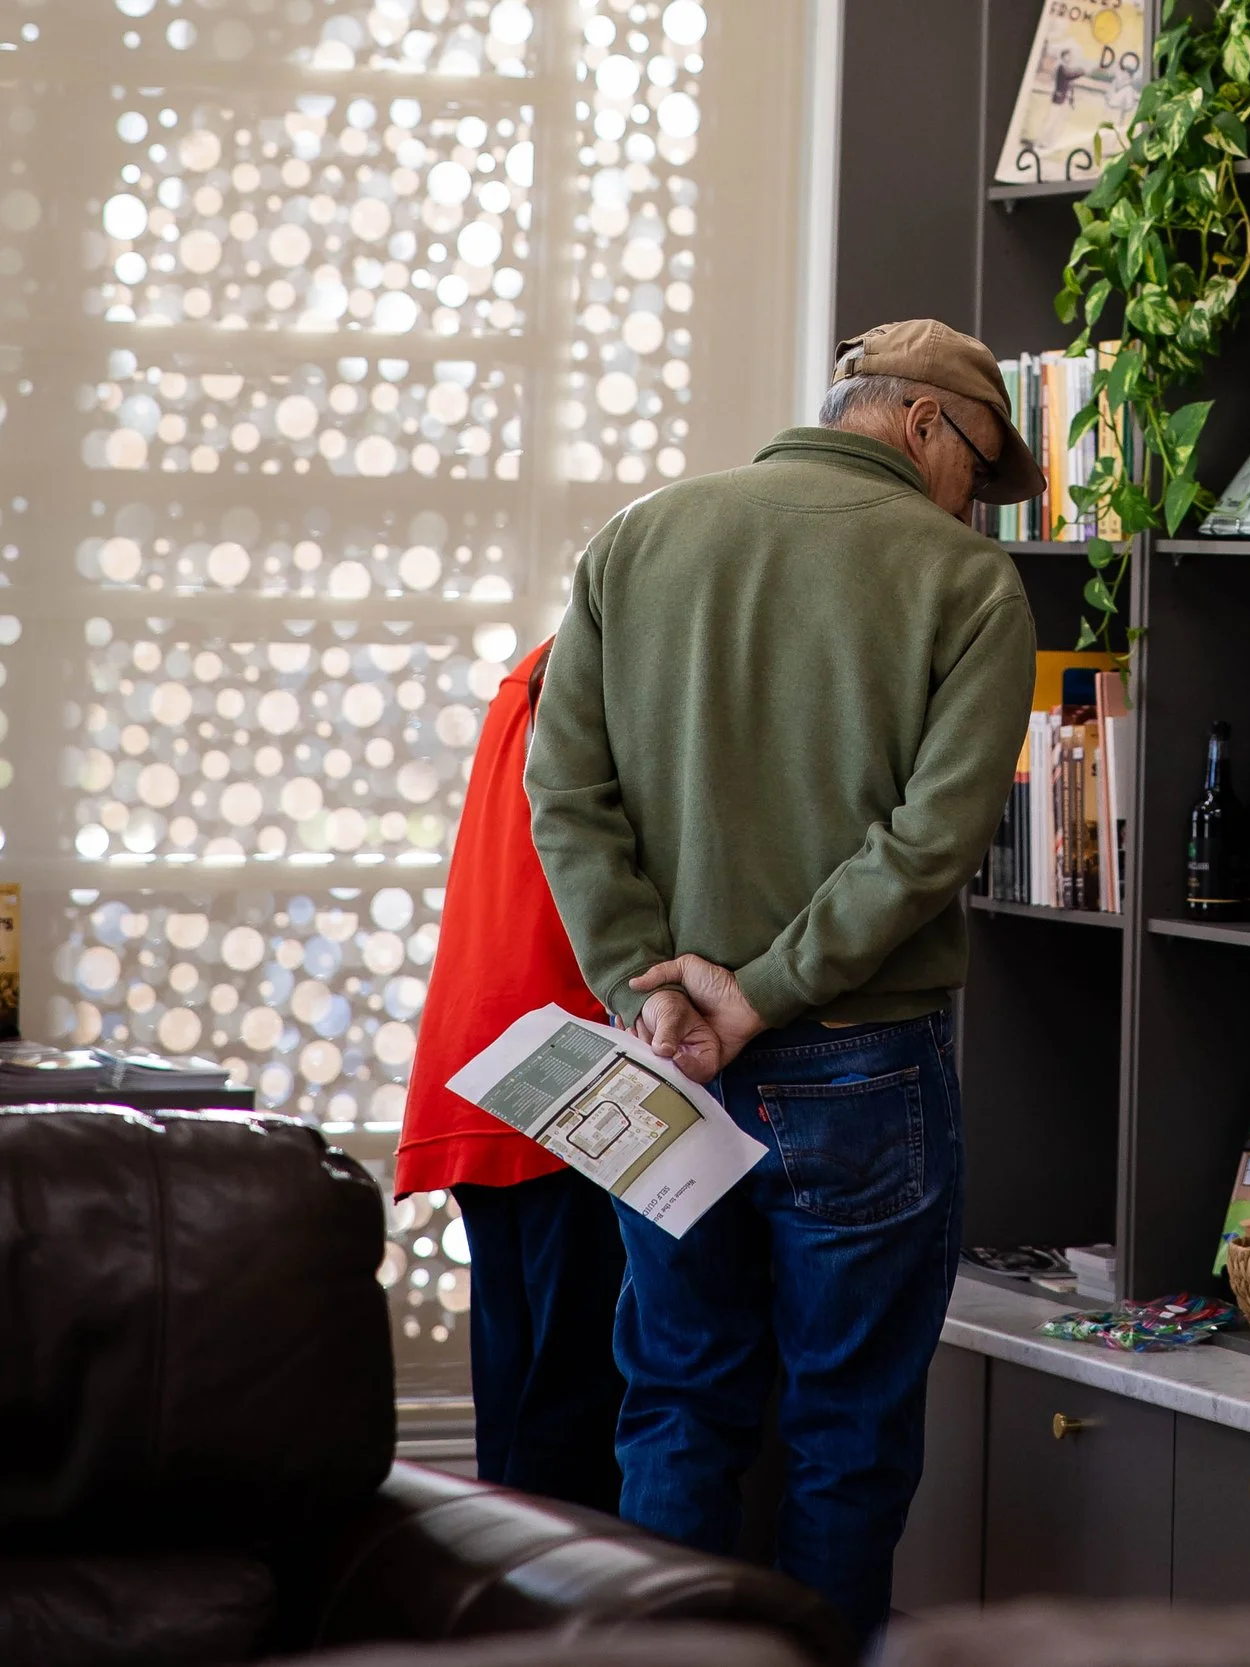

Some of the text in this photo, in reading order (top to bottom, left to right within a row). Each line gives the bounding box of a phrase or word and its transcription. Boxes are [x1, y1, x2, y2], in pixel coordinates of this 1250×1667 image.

[656, 1185, 671, 1201] SELF
[673, 1179, 697, 1198] Welcome
[661, 1203, 672, 1213] the
